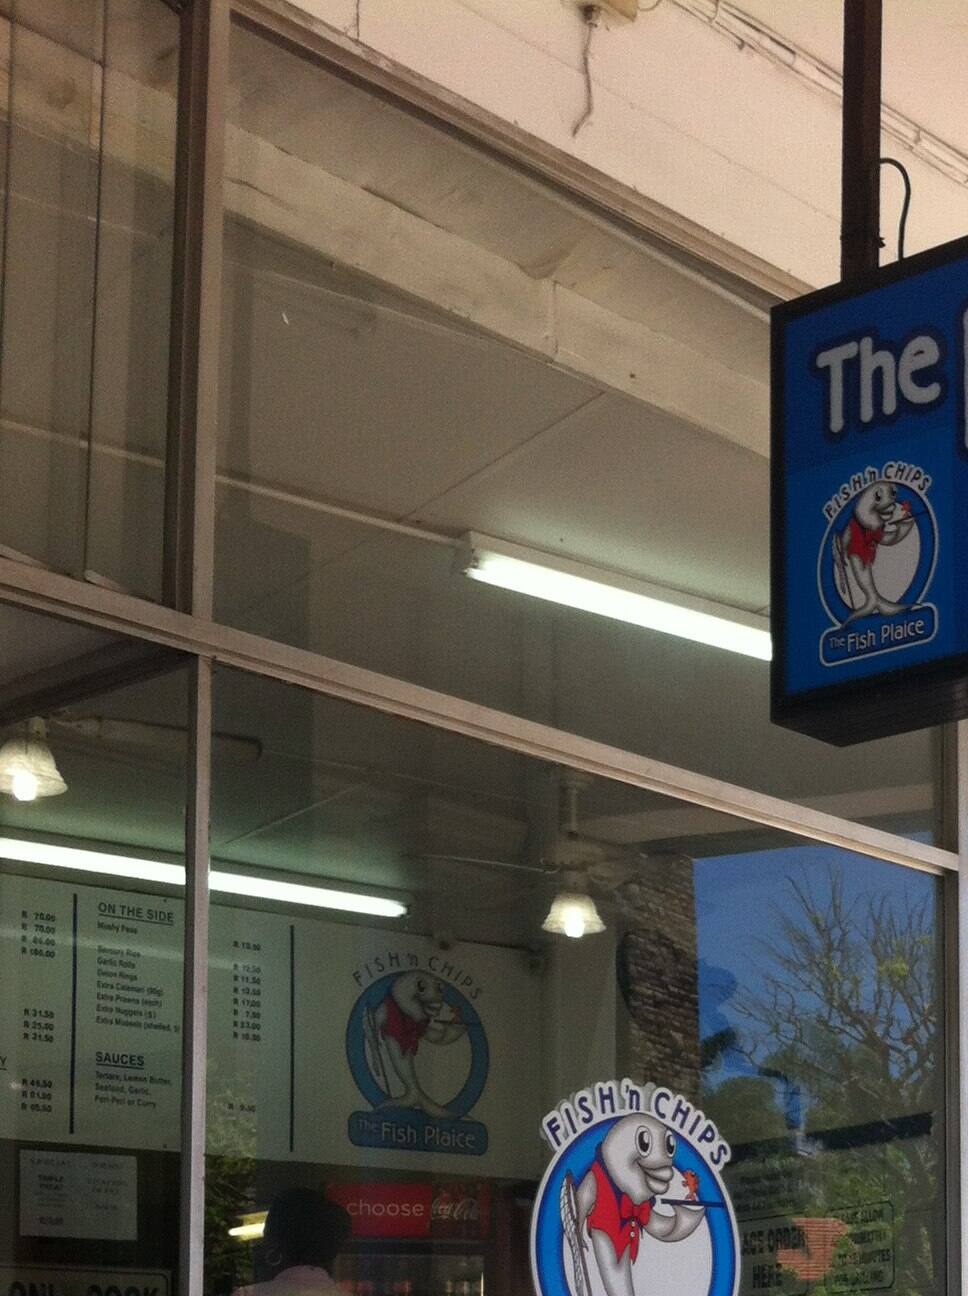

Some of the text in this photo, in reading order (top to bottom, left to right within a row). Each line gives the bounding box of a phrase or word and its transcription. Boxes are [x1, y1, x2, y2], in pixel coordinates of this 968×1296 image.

[816, 335, 942, 434] The
[825, 474, 868, 519] FISH
[883, 463, 931, 492] CHIPS
[829, 619, 925, 652] The Fish Plaice
[98, 902, 174, 922] ON THE SIDE
[352, 951, 400, 987] FISH
[428, 956, 482, 1000] CHIPS
[95, 1051, 145, 1067] SAUCES
[358, 1118, 476, 1148] The Fish Plaice
[547, 1086, 616, 1147] FISH
[654, 1092, 729, 1166] CHIPS
[346, 1198, 425, 1218] choose
